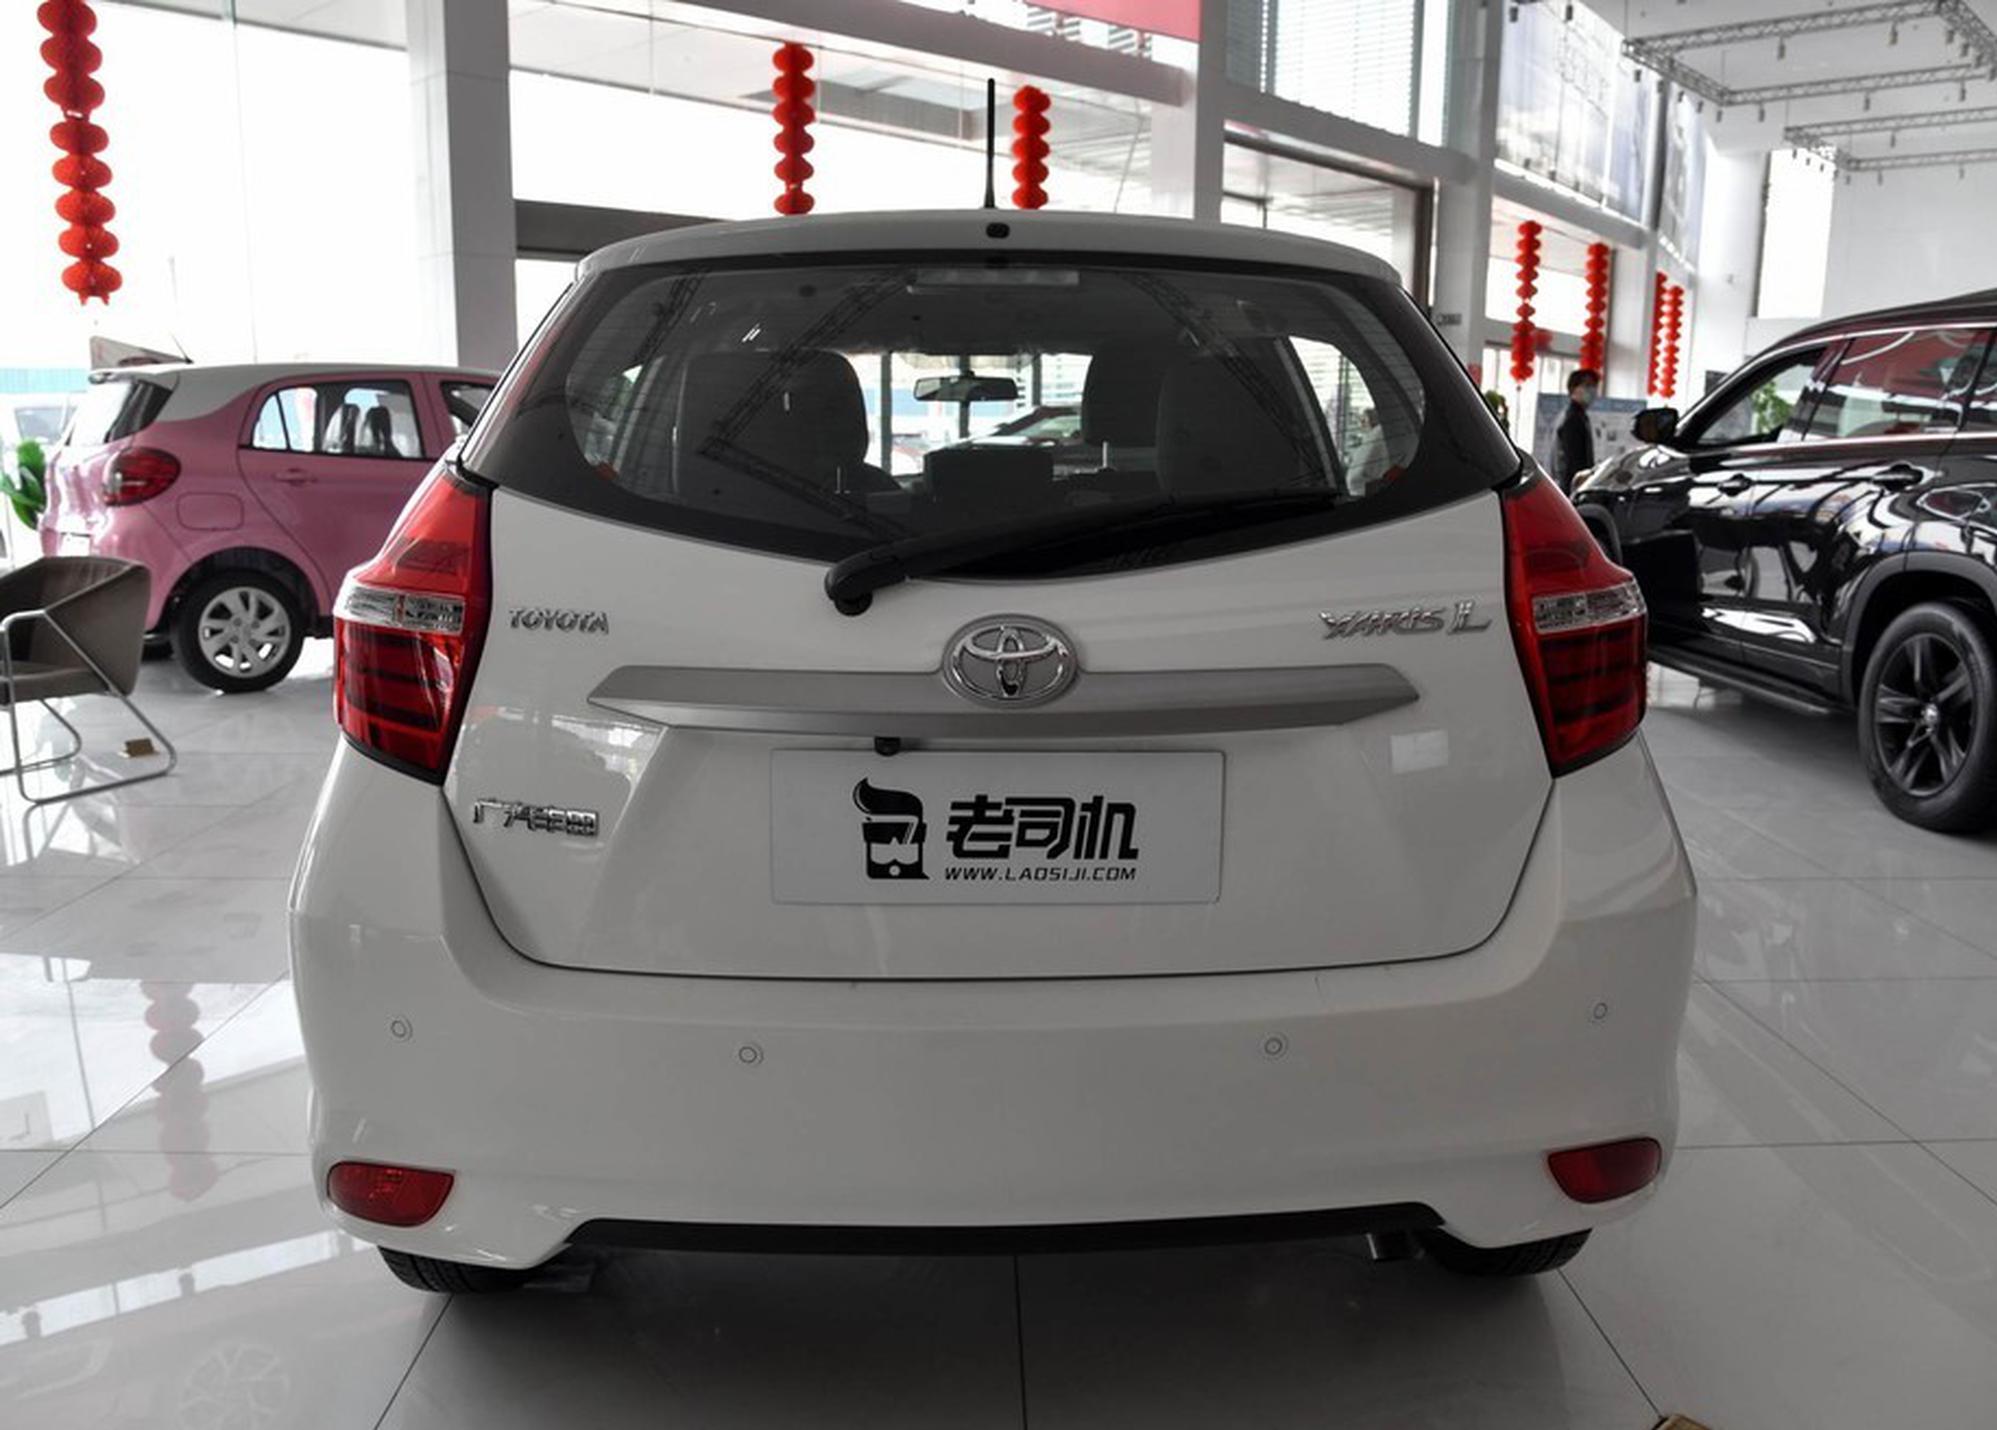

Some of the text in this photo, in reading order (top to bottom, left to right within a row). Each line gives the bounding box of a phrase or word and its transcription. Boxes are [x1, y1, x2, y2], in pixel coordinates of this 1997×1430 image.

[508, 609, 609, 634] TOYOTA
[946, 794, 1140, 860] 老司机
[945, 866, 1137, 882] WWW.LAOSIJI.COM
